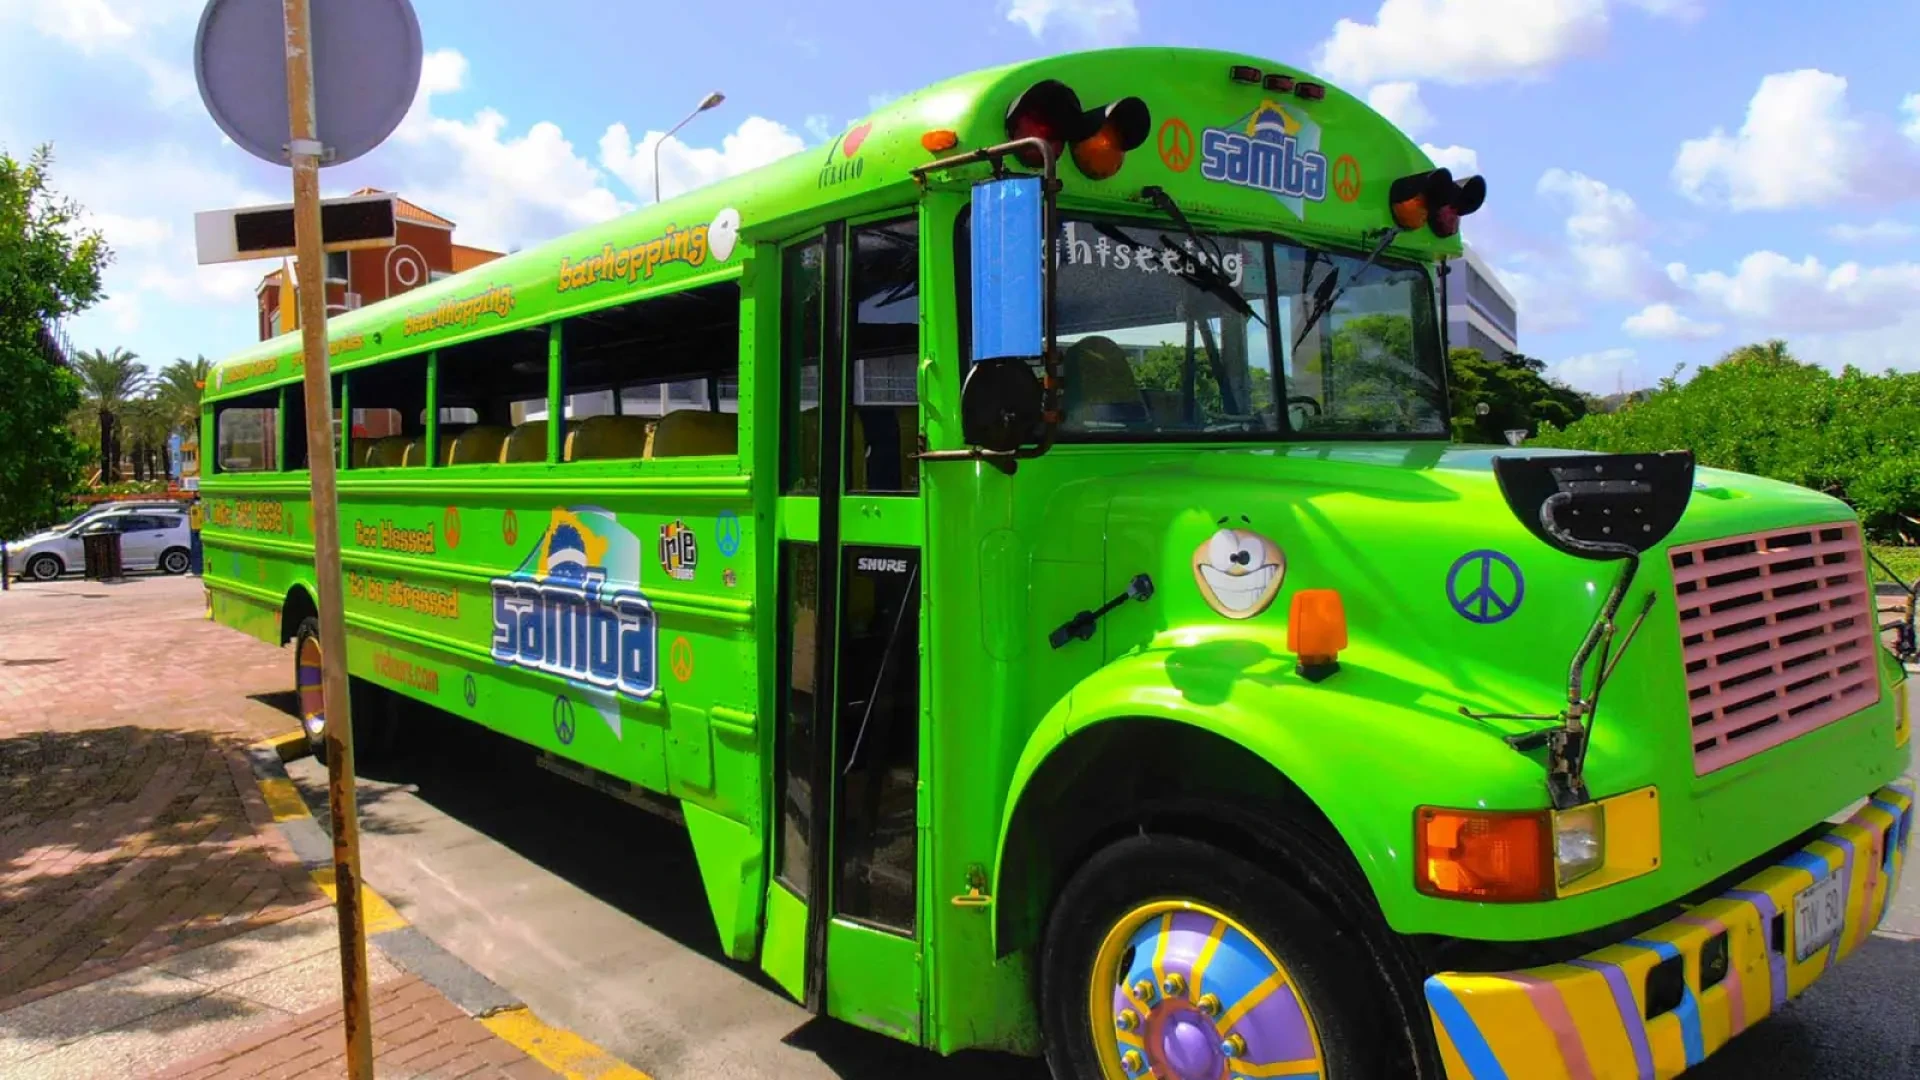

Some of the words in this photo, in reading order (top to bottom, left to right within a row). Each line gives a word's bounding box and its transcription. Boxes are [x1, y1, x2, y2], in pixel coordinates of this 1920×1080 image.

[1202, 127, 1327, 202] samba
[558, 222, 710, 293] barhopping
[380, 518, 436, 554] blessed
[857, 557, 908, 573] SHURE
[387, 578, 460, 620] stressed
[491, 569, 659, 698] samba
